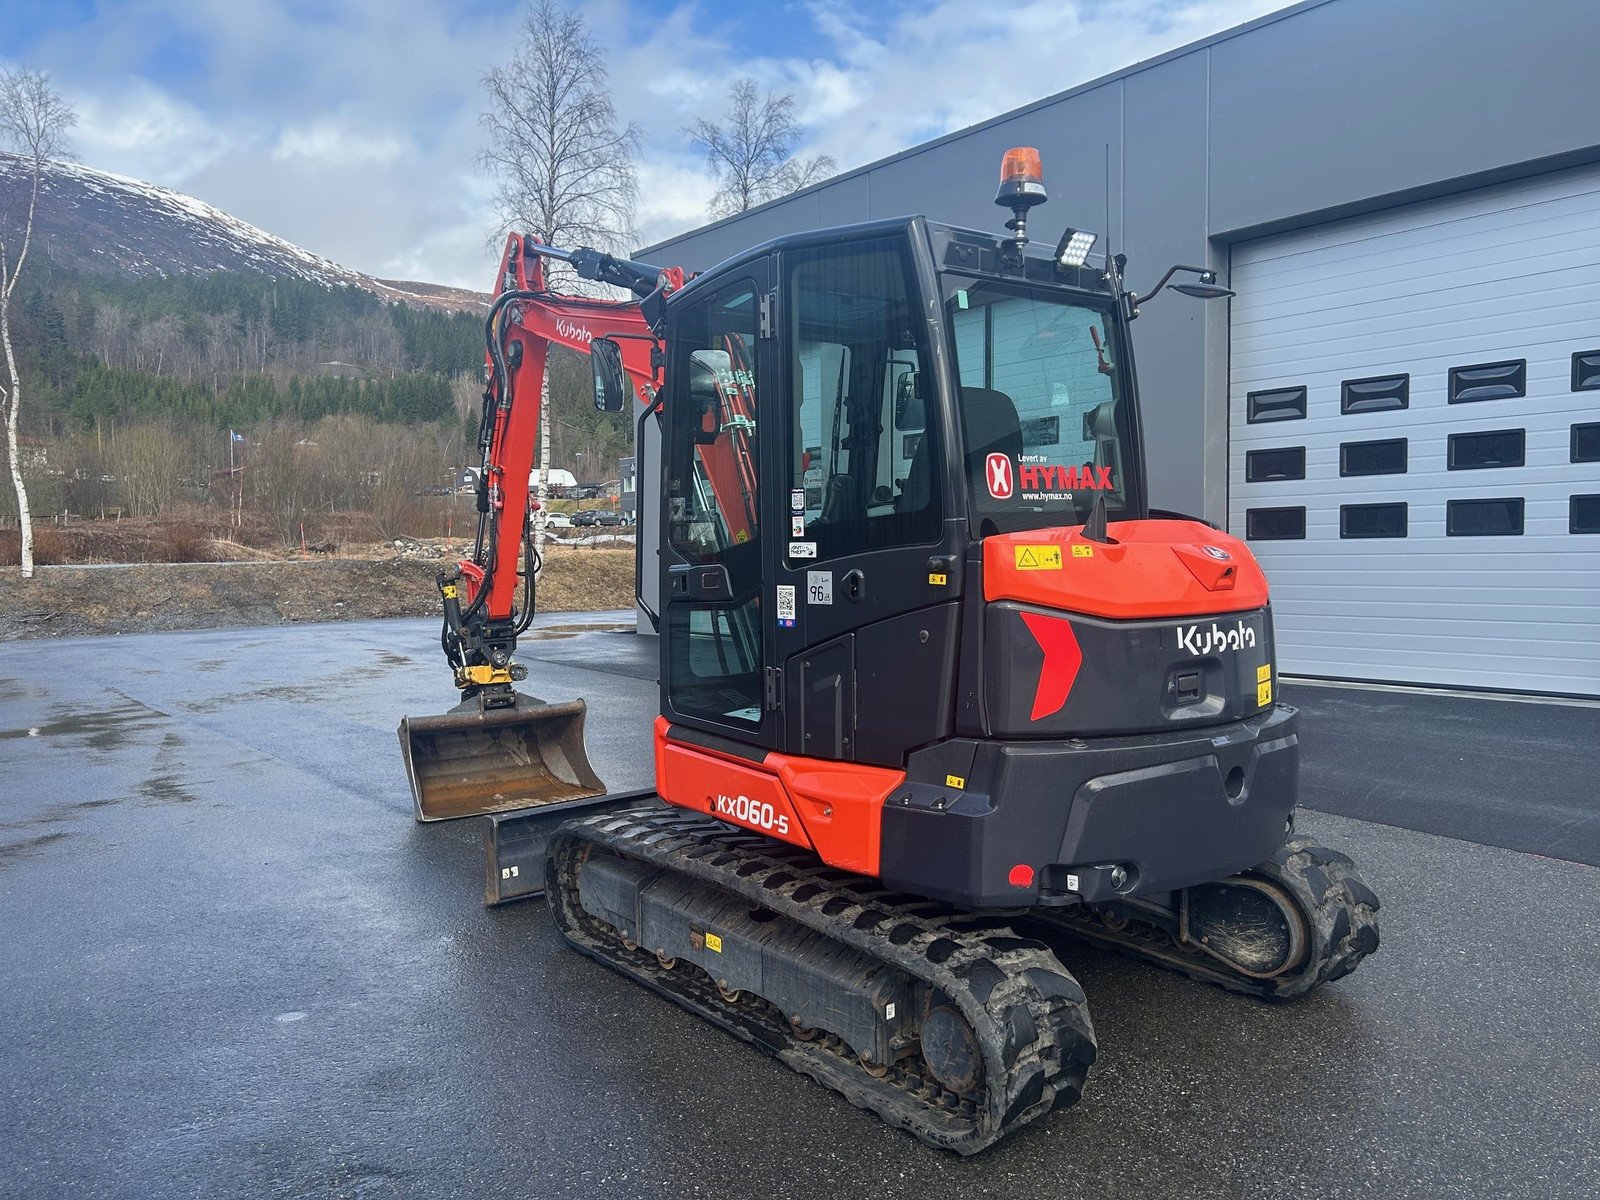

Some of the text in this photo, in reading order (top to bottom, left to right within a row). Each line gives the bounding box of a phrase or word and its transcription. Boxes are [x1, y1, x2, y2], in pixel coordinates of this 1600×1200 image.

[556, 319, 592, 343] Kubota
[1018, 454, 1047, 463] Levert av
[1020, 464, 1113, 490] HYMAX
[1022, 492, 1073, 502] www.hymax.no
[810, 586, 823, 601] 96
[1177, 620, 1256, 656] Kubota
[717, 794, 789, 835] KX060-5
